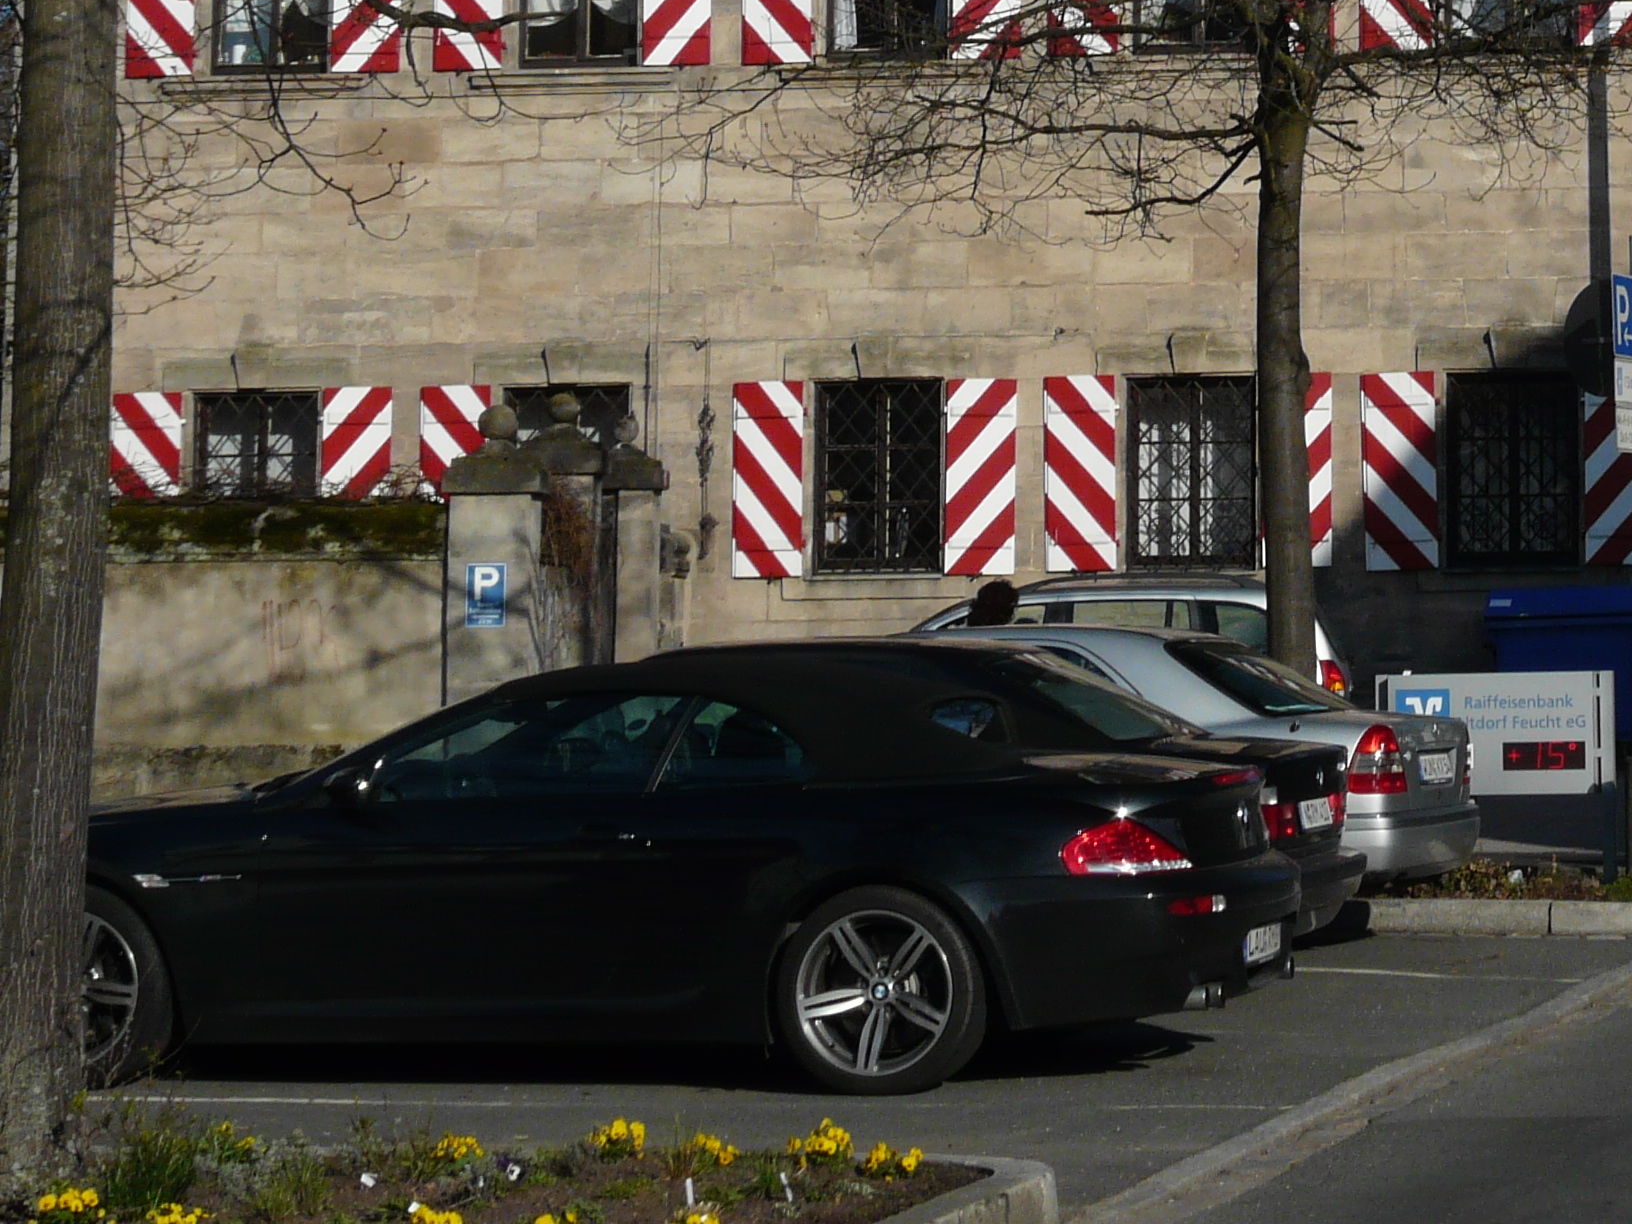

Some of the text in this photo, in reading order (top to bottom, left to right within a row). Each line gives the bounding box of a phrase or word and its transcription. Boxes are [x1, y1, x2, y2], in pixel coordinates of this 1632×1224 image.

[1616, 284, 1630, 345] P
[474, 566, 500, 600] P
[1464, 694, 1573, 709] Raiffeisenbank
[1466, 715, 1586, 730] ltdorf Feucht eG
